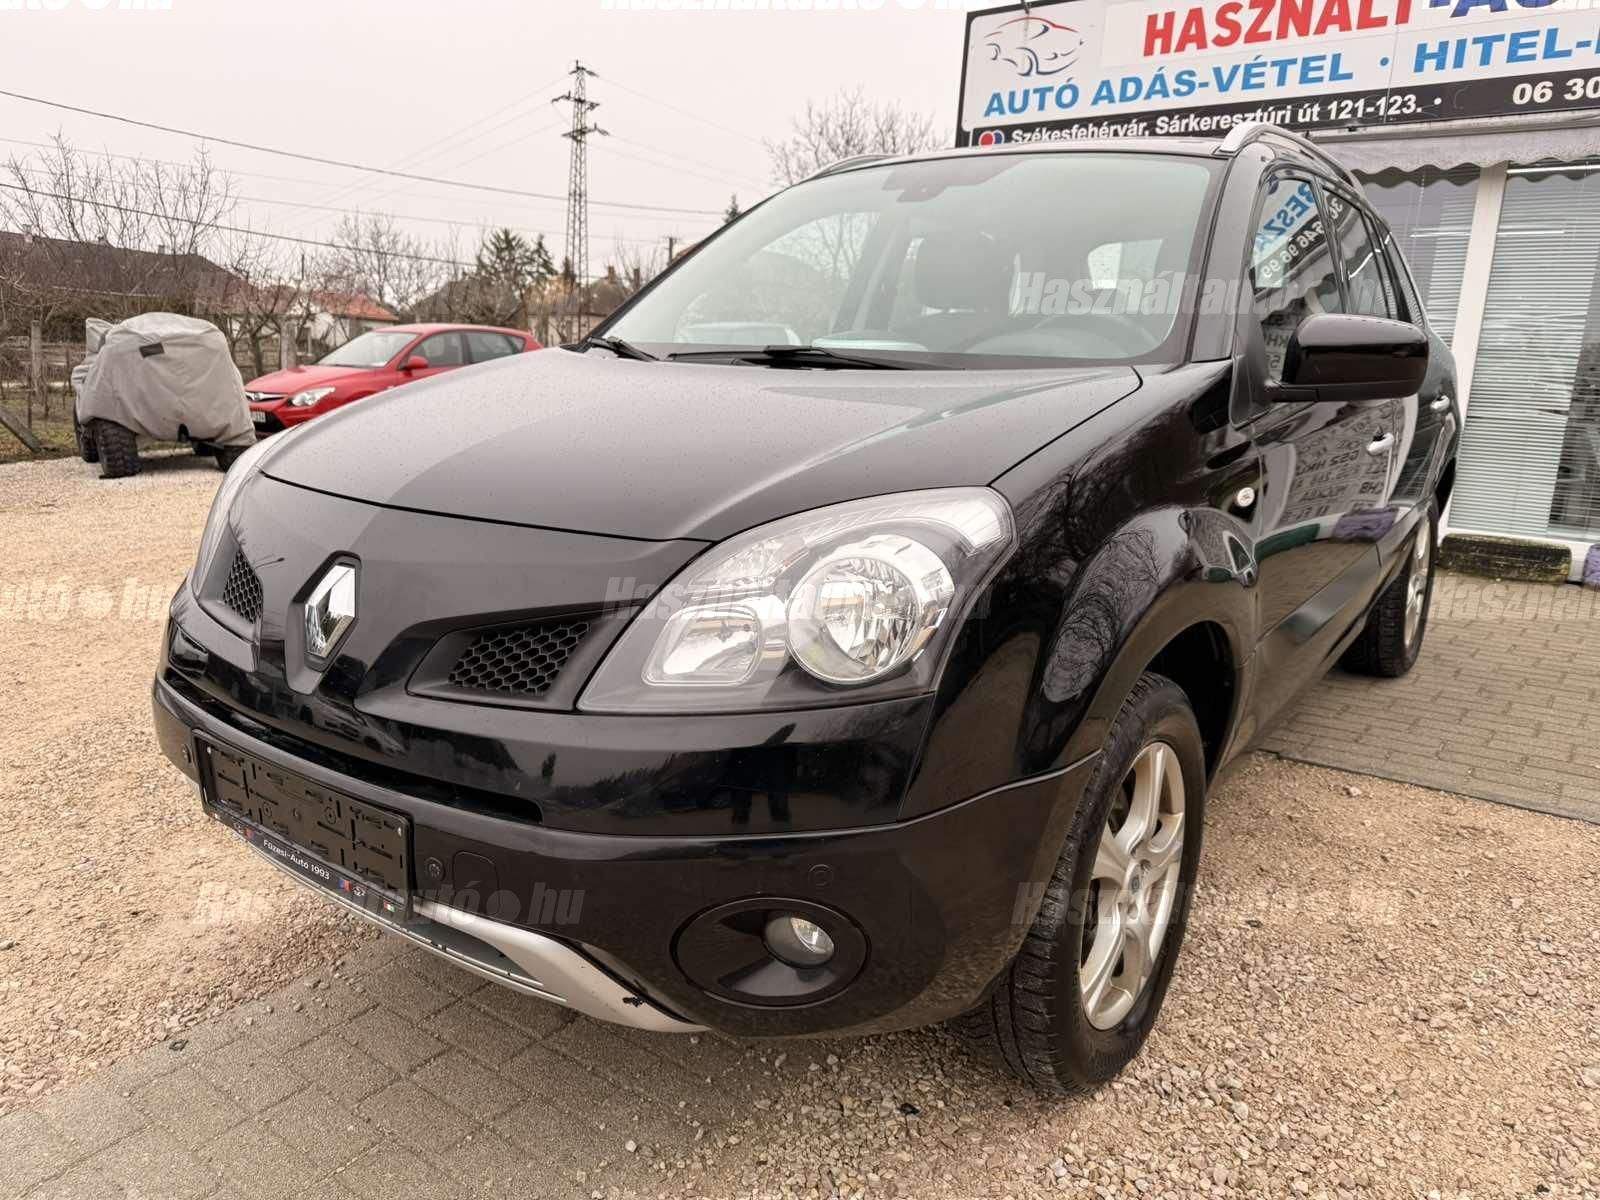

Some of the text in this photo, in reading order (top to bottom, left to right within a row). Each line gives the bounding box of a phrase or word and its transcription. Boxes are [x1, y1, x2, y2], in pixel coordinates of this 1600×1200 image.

[984, 25, 1600, 118] AUTÓ ADÁS-VÉTEL HITEL-
[1513, 81, 1553, 105] 06
[1011, 94, 1423, 144] Székesfehérvár, Sárkeresztúri út 121-123.
[311, 864, 330, 880] 1993
